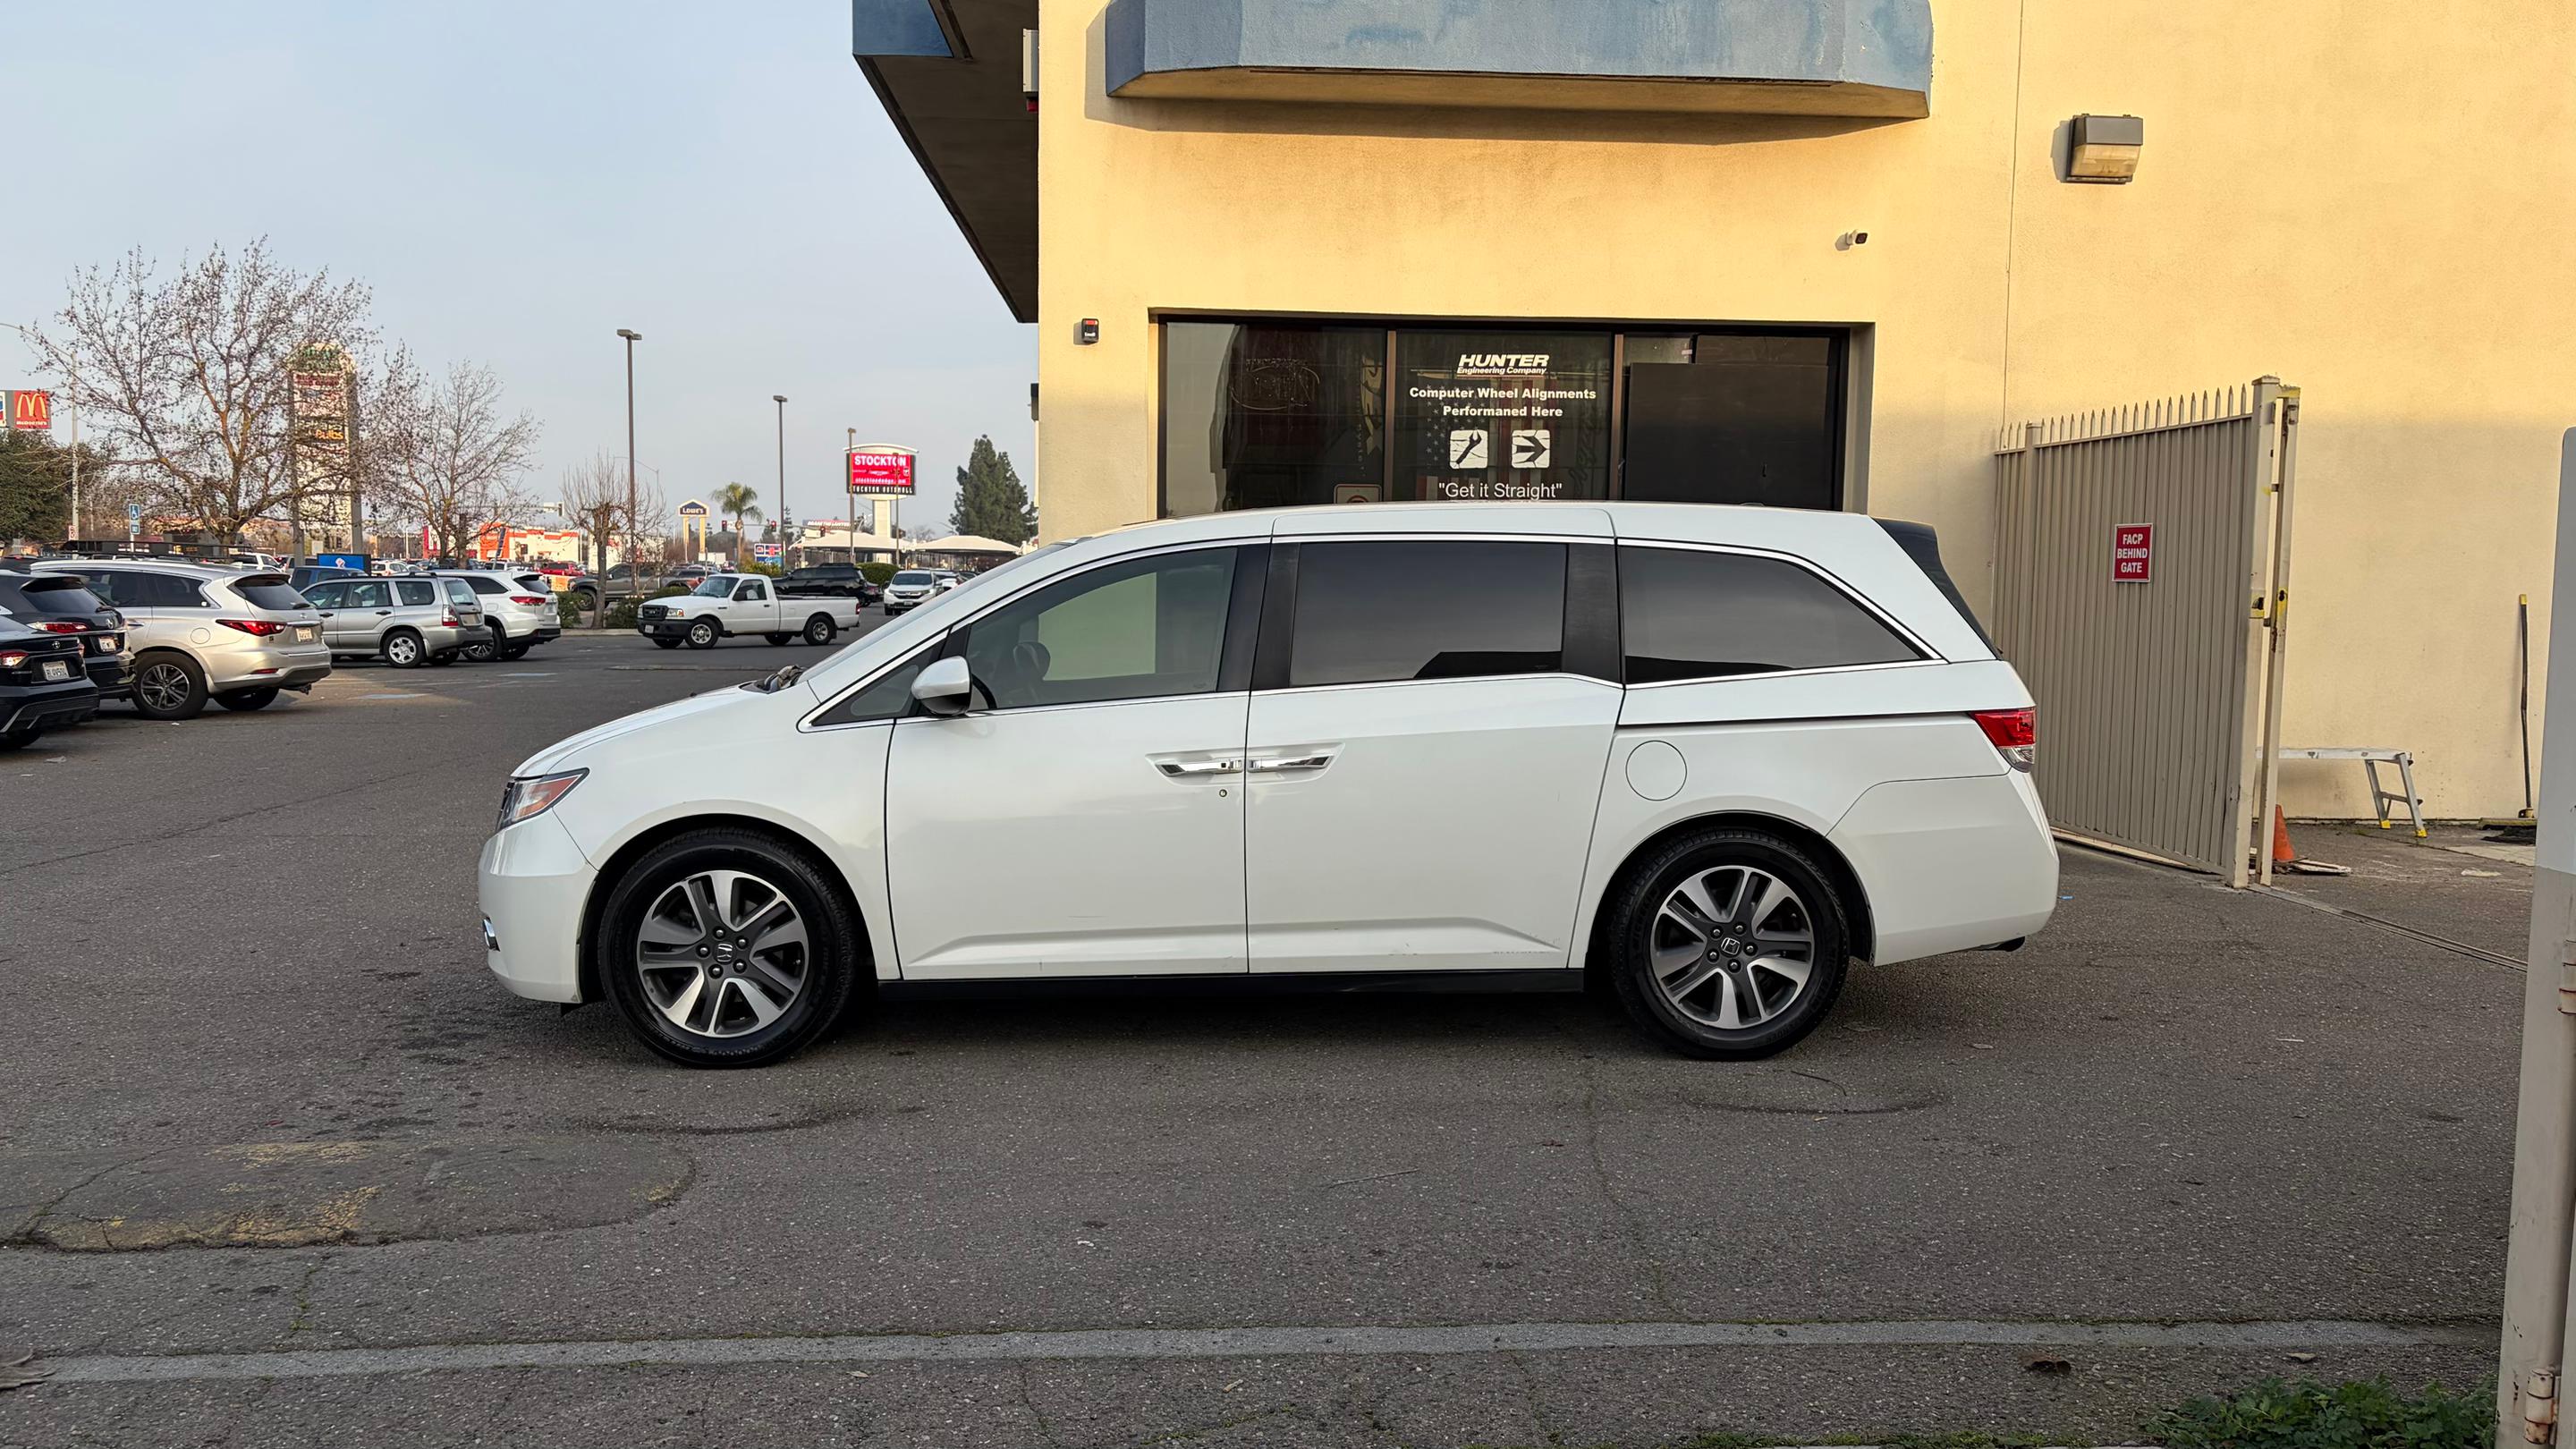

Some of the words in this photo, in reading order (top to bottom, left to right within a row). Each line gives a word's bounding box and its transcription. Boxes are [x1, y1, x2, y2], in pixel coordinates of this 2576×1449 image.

[1458, 354, 1550, 367] HUNTER
[1456, 367, 1505, 375] Engineering
[1506, 367, 1546, 375] Company
[1410, 387, 1474, 400] Computer
[1478, 387, 1519, 399] Wheel
[1521, 387, 1597, 401] Alignments
[1443, 405, 1527, 417] Performaned
[1531, 406, 1563, 417] Here
[854, 455, 907, 467] STOCKTON
[1438, 483, 1476, 497] "Get
[1479, 483, 1489, 497] it
[1494, 483, 1563, 499] Straight"
[2123, 533, 2143, 545] FACP
[2116, 547, 2148, 559] BEHIND
[2121, 562, 2143, 572] GATE
